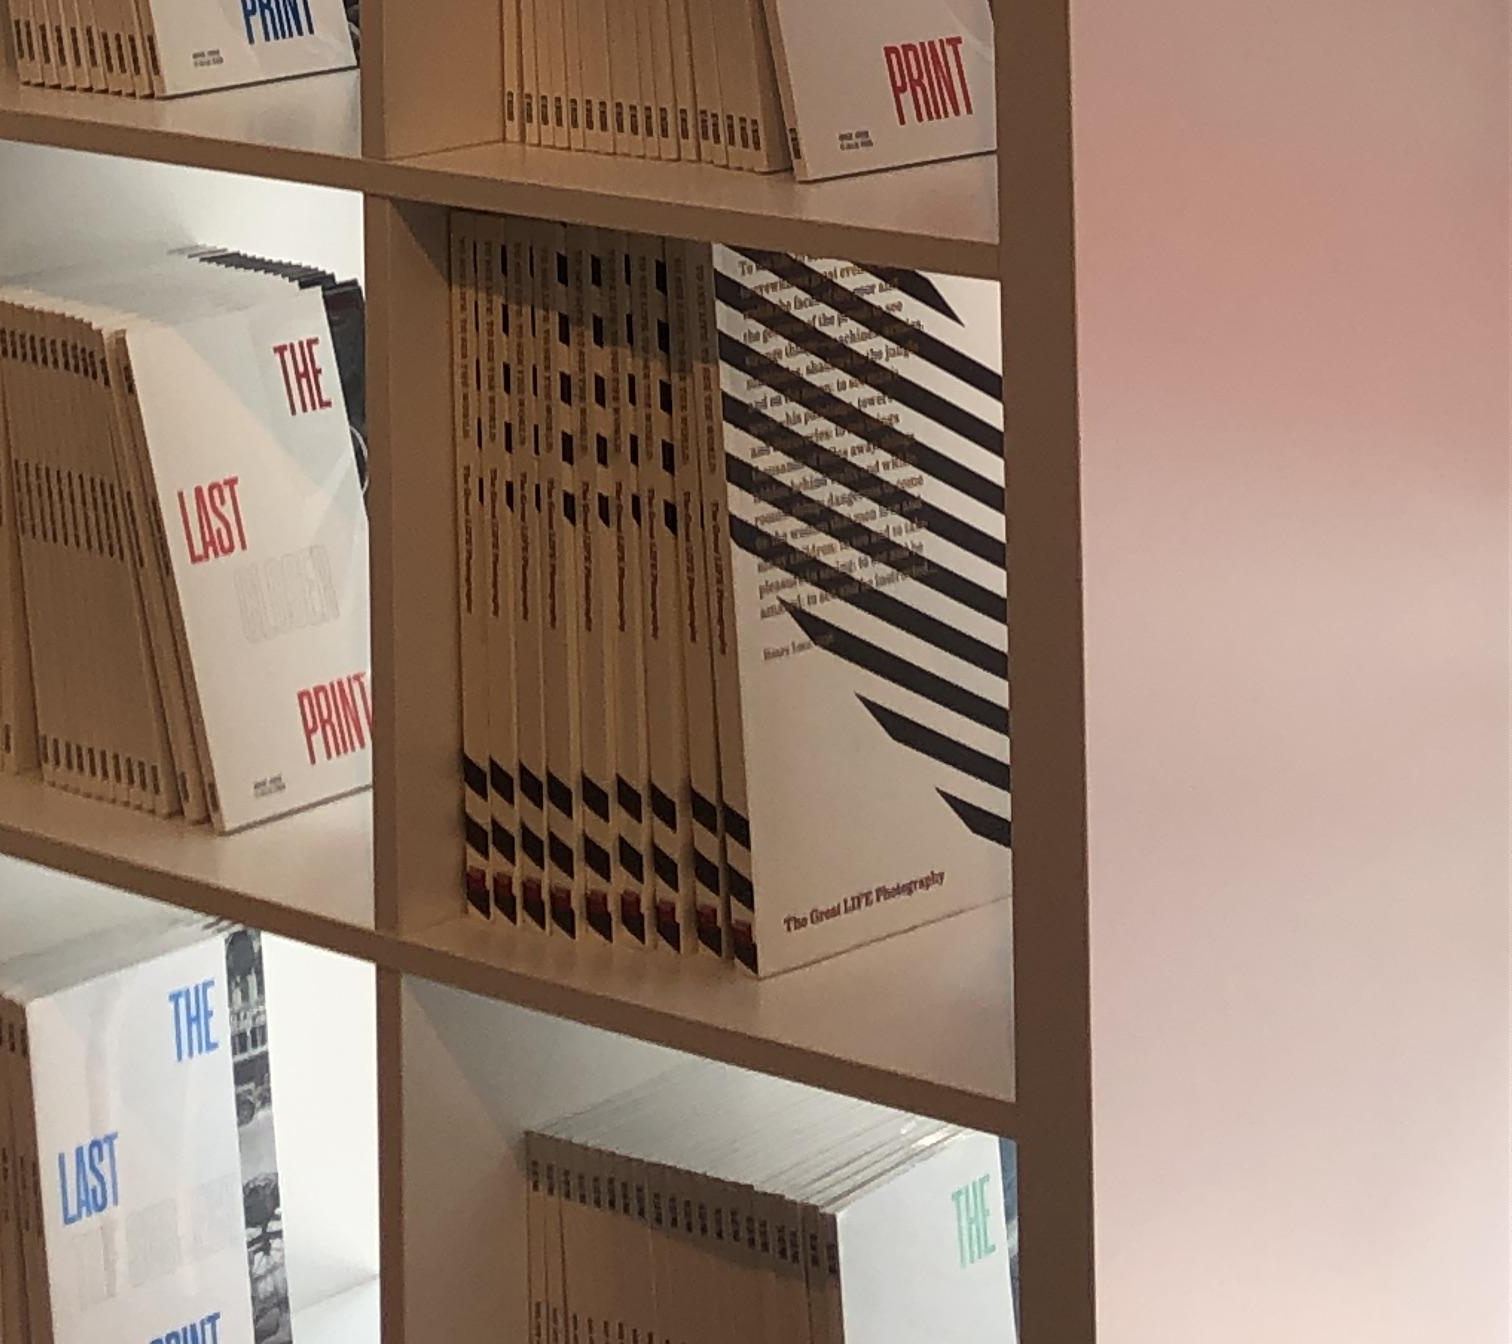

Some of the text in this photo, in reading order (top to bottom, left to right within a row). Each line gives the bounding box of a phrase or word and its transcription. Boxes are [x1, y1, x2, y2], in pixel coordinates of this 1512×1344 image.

[883, 36, 972, 125] PRINT
[273, 337, 332, 416] THE
[177, 476, 247, 564] LAST
[297, 673, 372, 764] PRINT
[783, 914, 808, 933] The
[810, 903, 841, 925] Great
[843, 889, 873, 914] LIFE
[168, 979, 220, 1062] THE
[57, 1132, 119, 1226] LAST
[951, 1173, 996, 1269] THE
